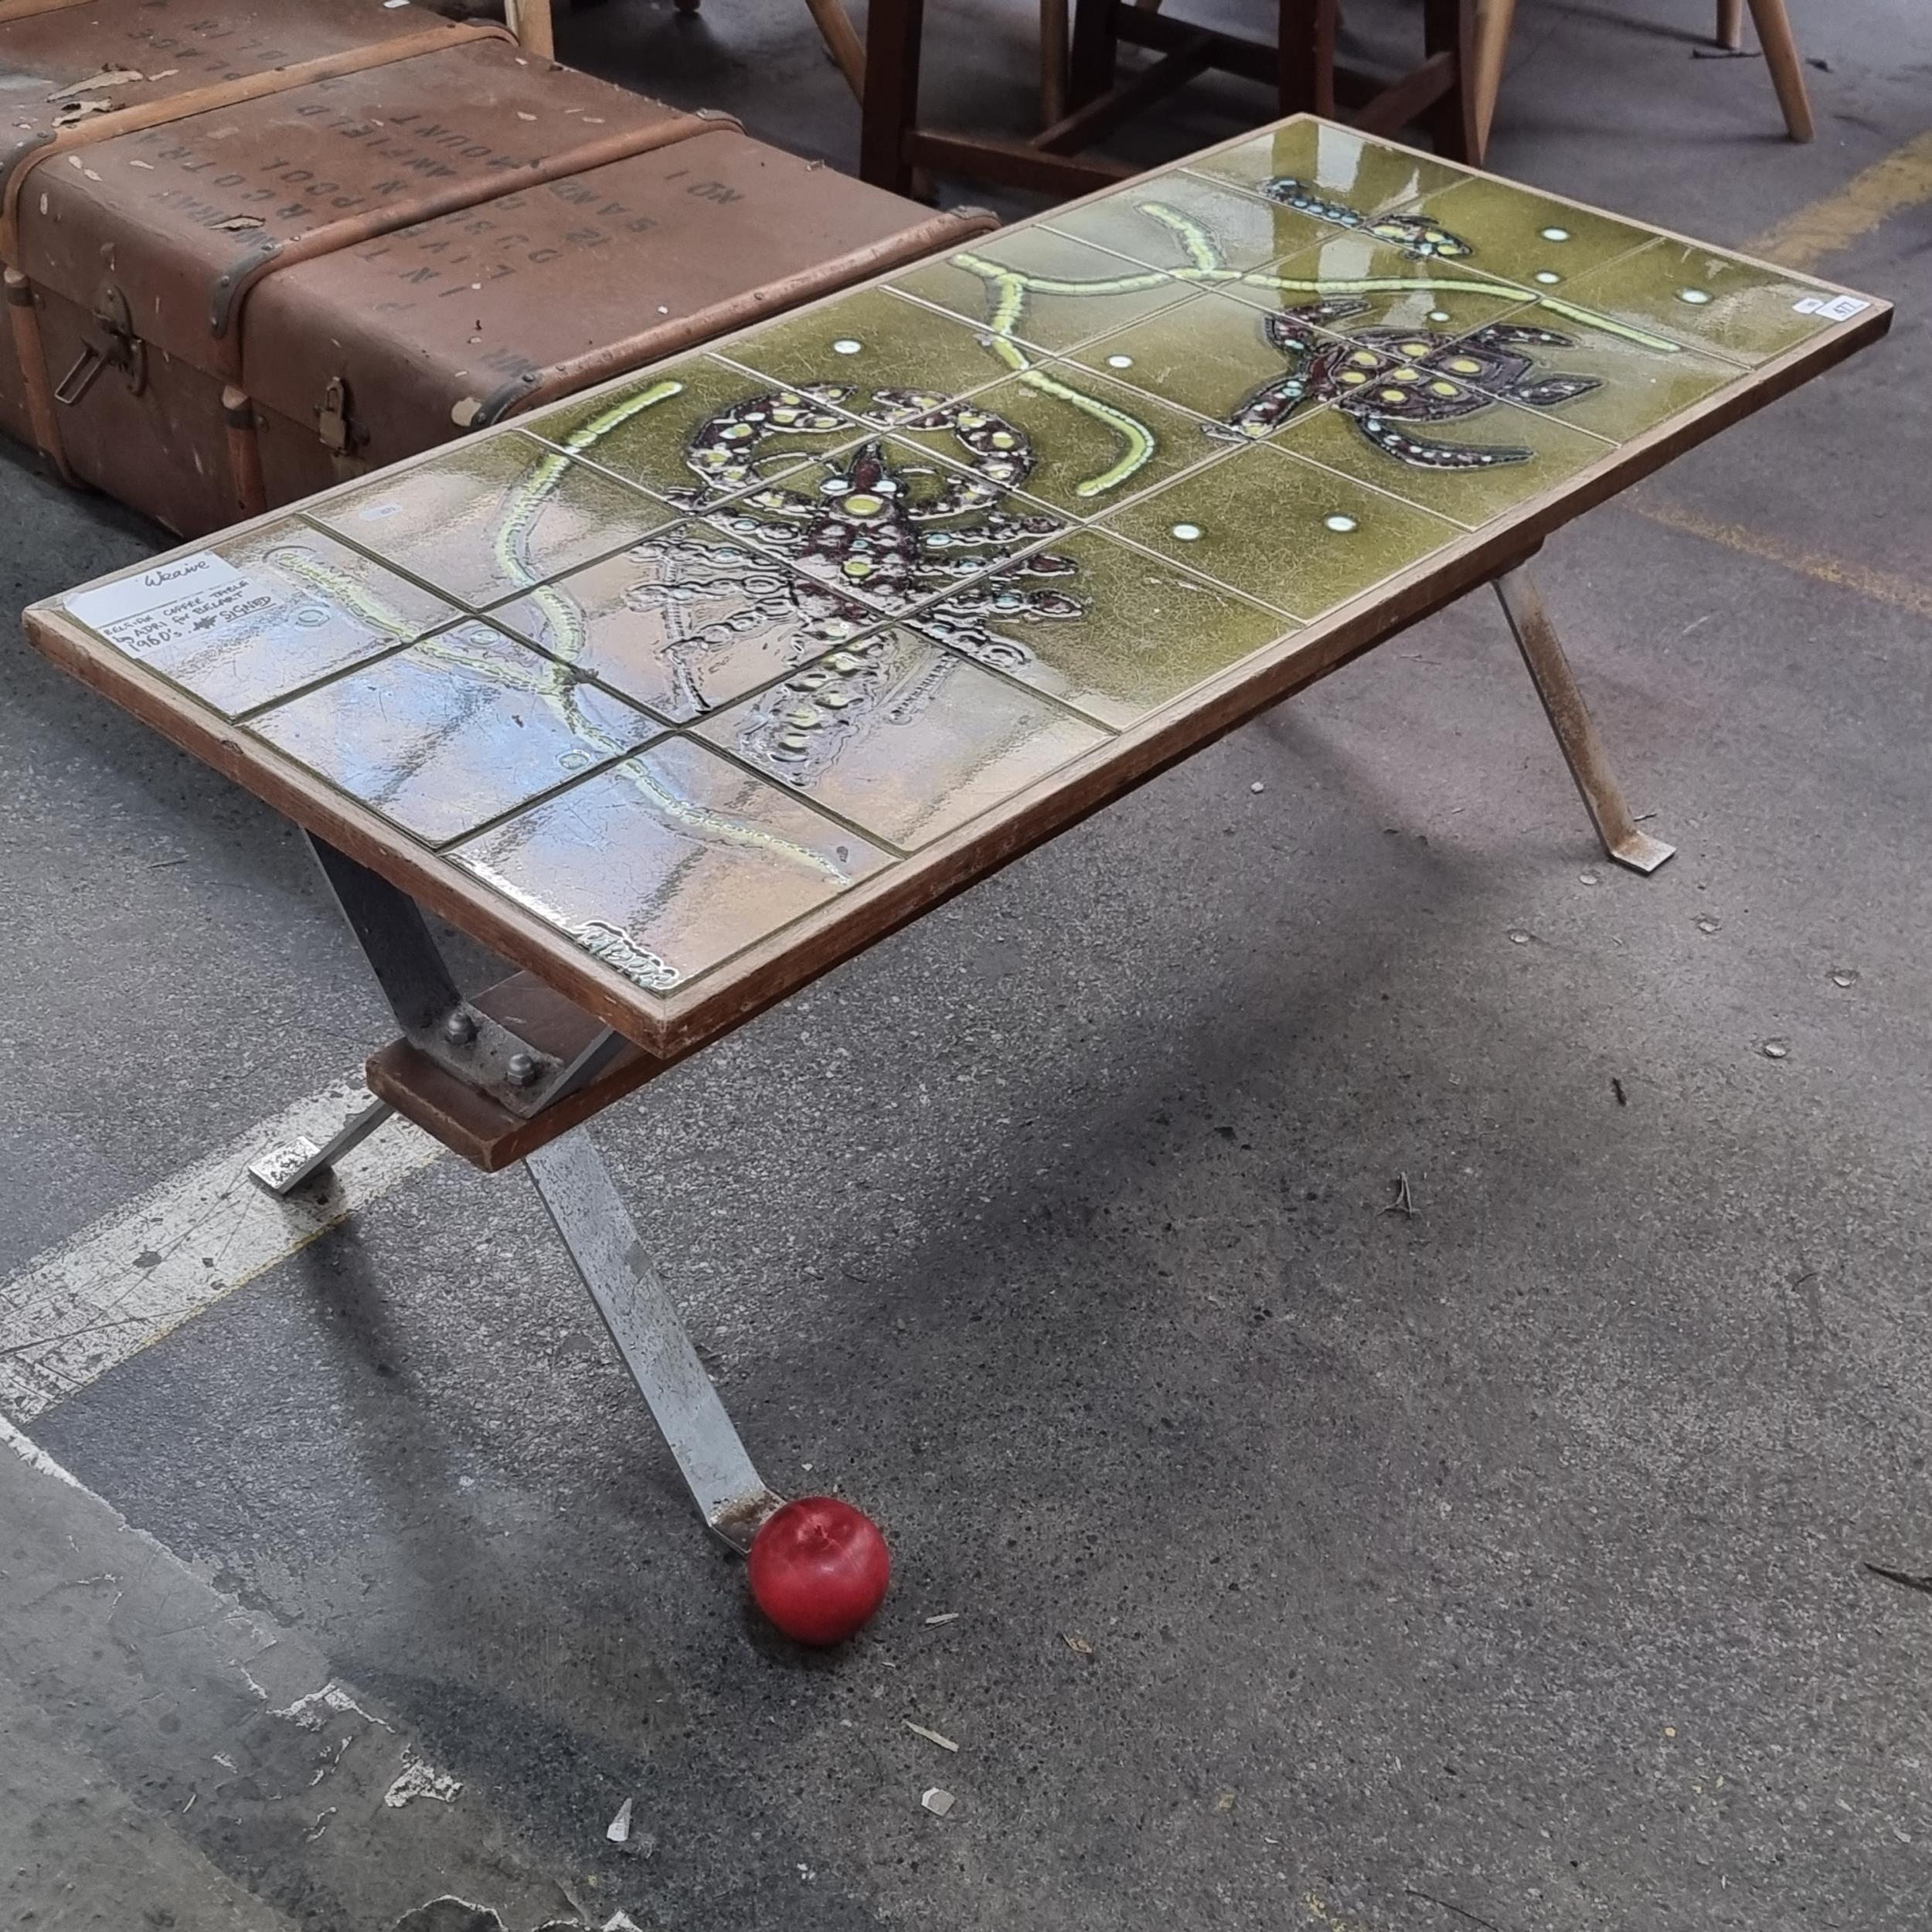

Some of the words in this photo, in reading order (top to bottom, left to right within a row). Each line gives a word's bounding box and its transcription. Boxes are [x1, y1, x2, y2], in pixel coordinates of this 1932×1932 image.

[104, 614, 154, 635] BELGIAN
[163, 597, 204, 617] COFFEE
[209, 580, 250, 598] TABLE
[112, 635, 135, 645] by
[134, 620, 168, 638] ADRI
[172, 613, 191, 625] for
[192, 590, 244, 615] BELART
[219, 596, 272, 621] SIGNED
